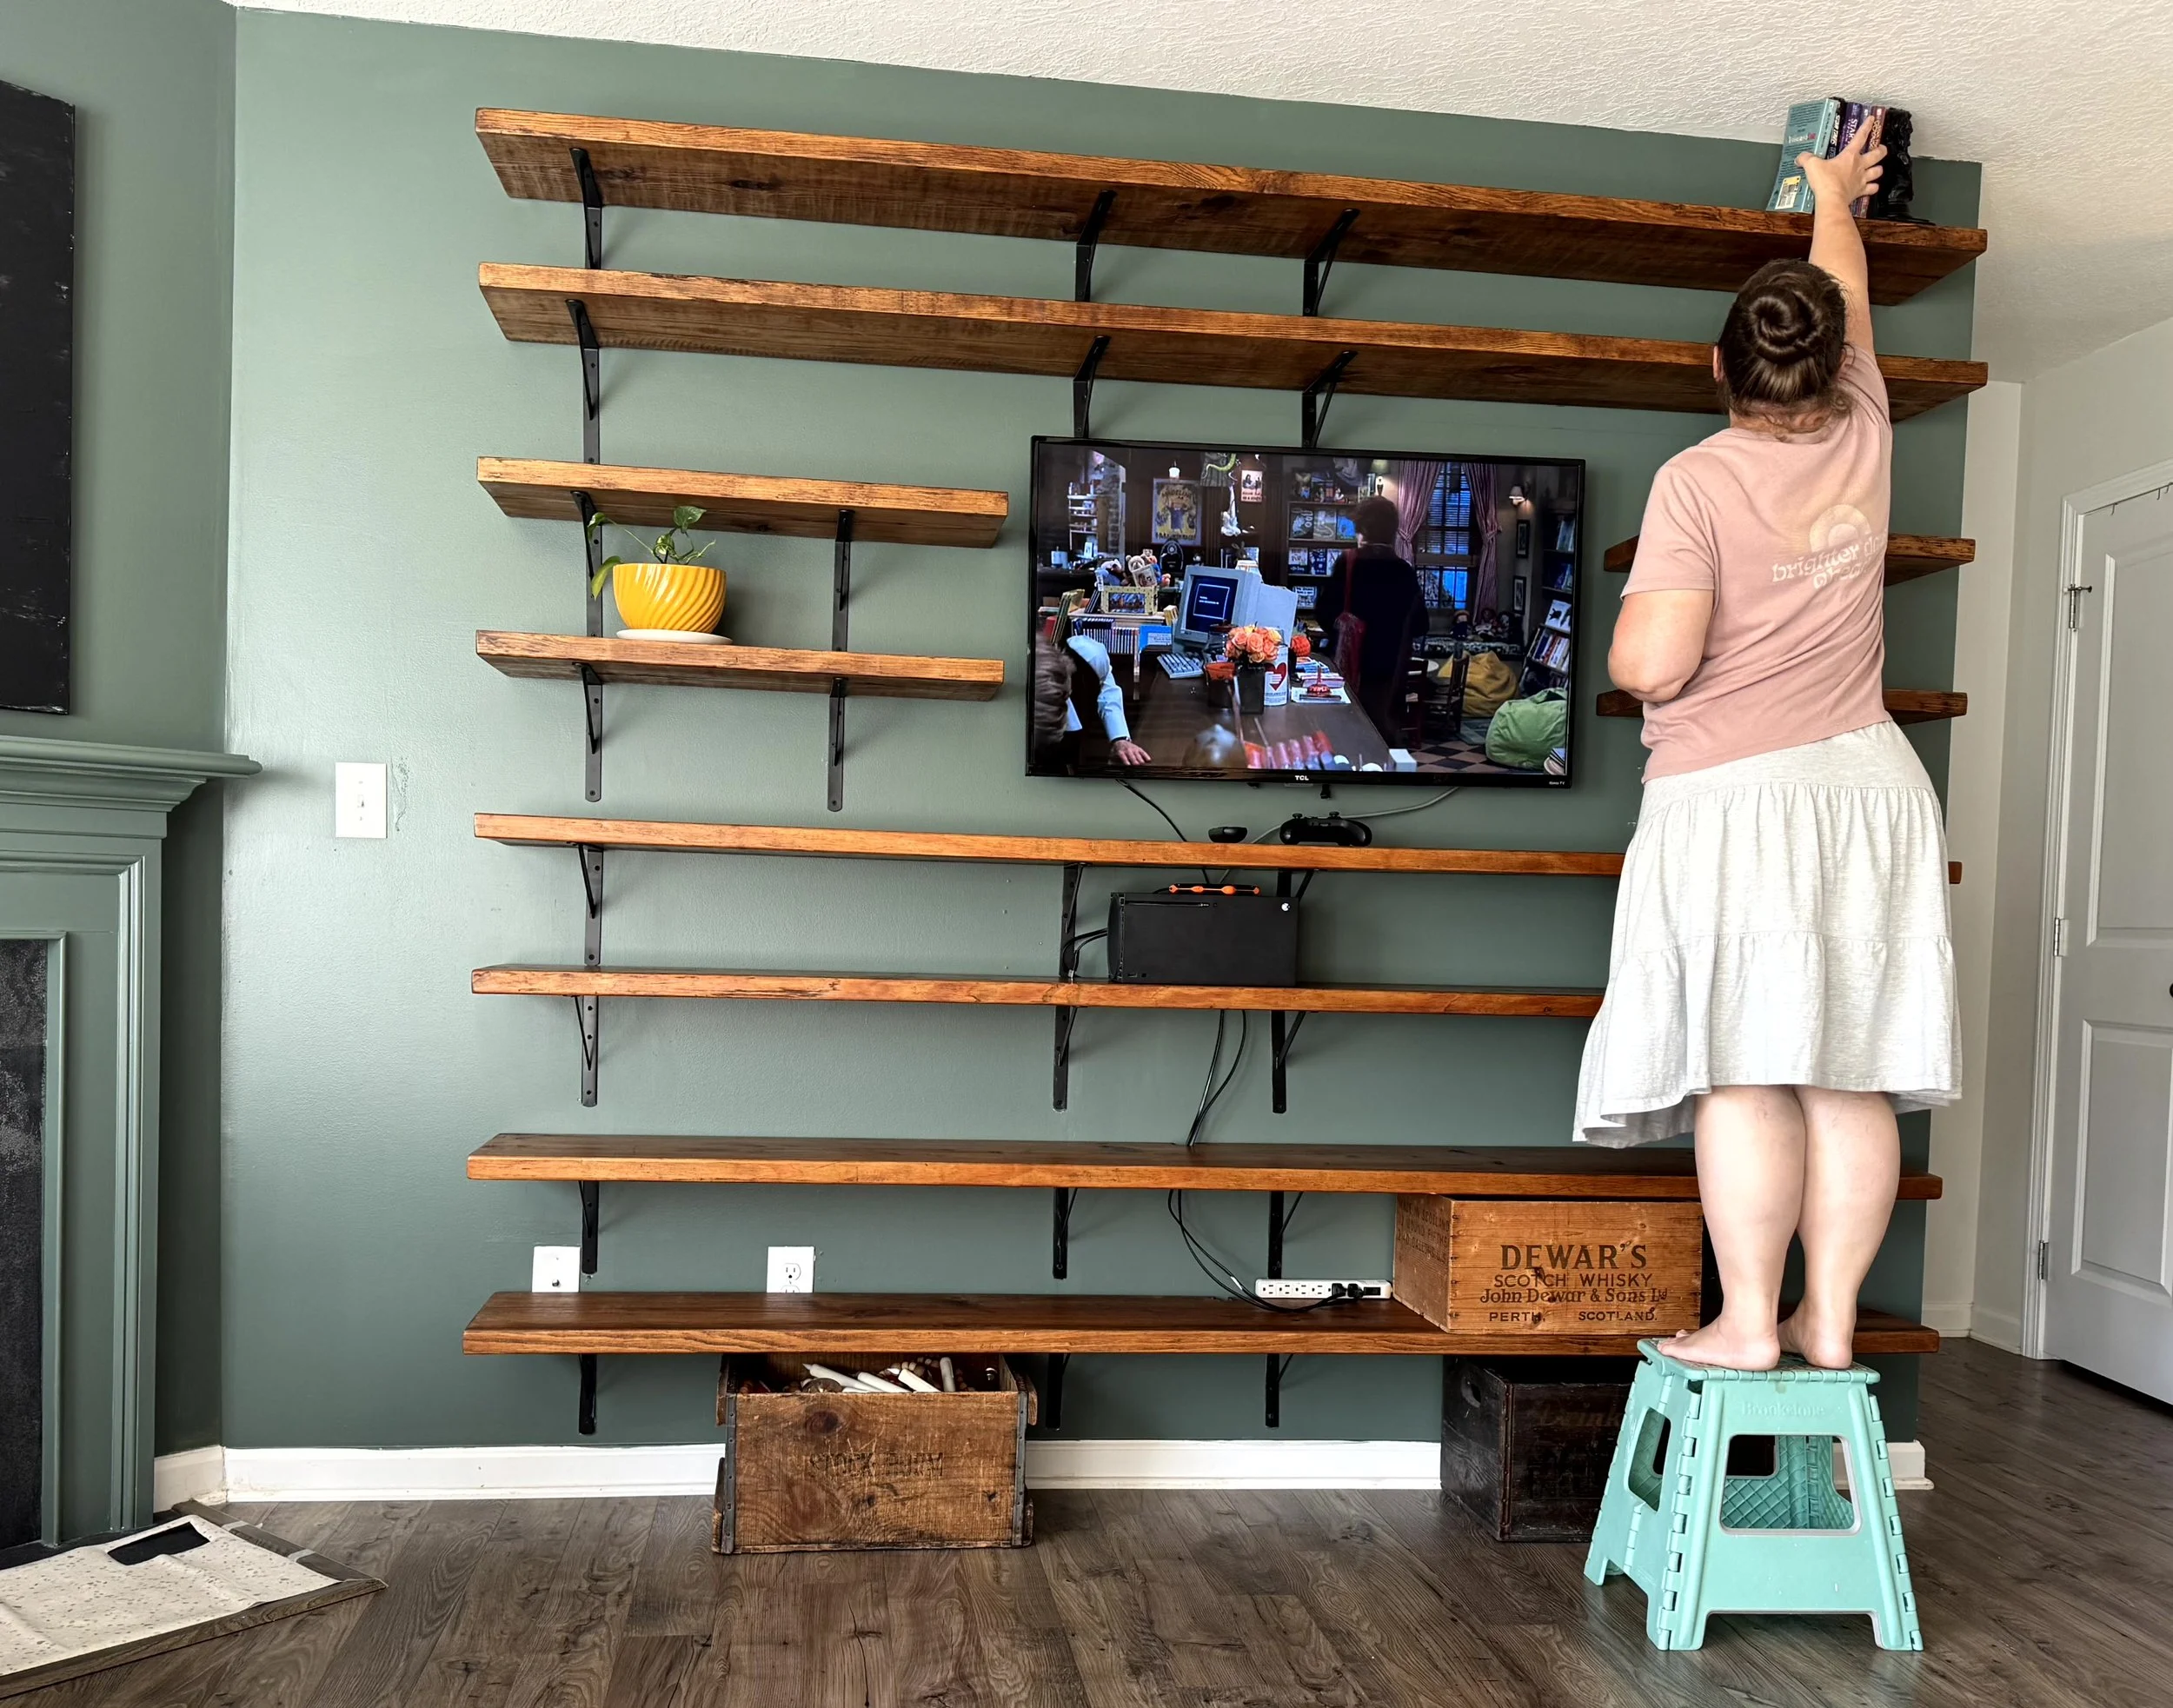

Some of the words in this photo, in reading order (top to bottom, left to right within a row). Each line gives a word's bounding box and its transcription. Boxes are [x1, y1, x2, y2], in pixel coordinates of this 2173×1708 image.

[1500, 1244, 1647, 1270] DEWAR'S
[1494, 1273, 1566, 1288] SCOTCH
[1579, 1273, 1653, 1287] WHISKY
[1479, 1288, 1522, 1304] John
[1525, 1288, 1586, 1303] Dewar
[1590, 1288, 1605, 1303] &
[1605, 1288, 1646, 1302] Sons
